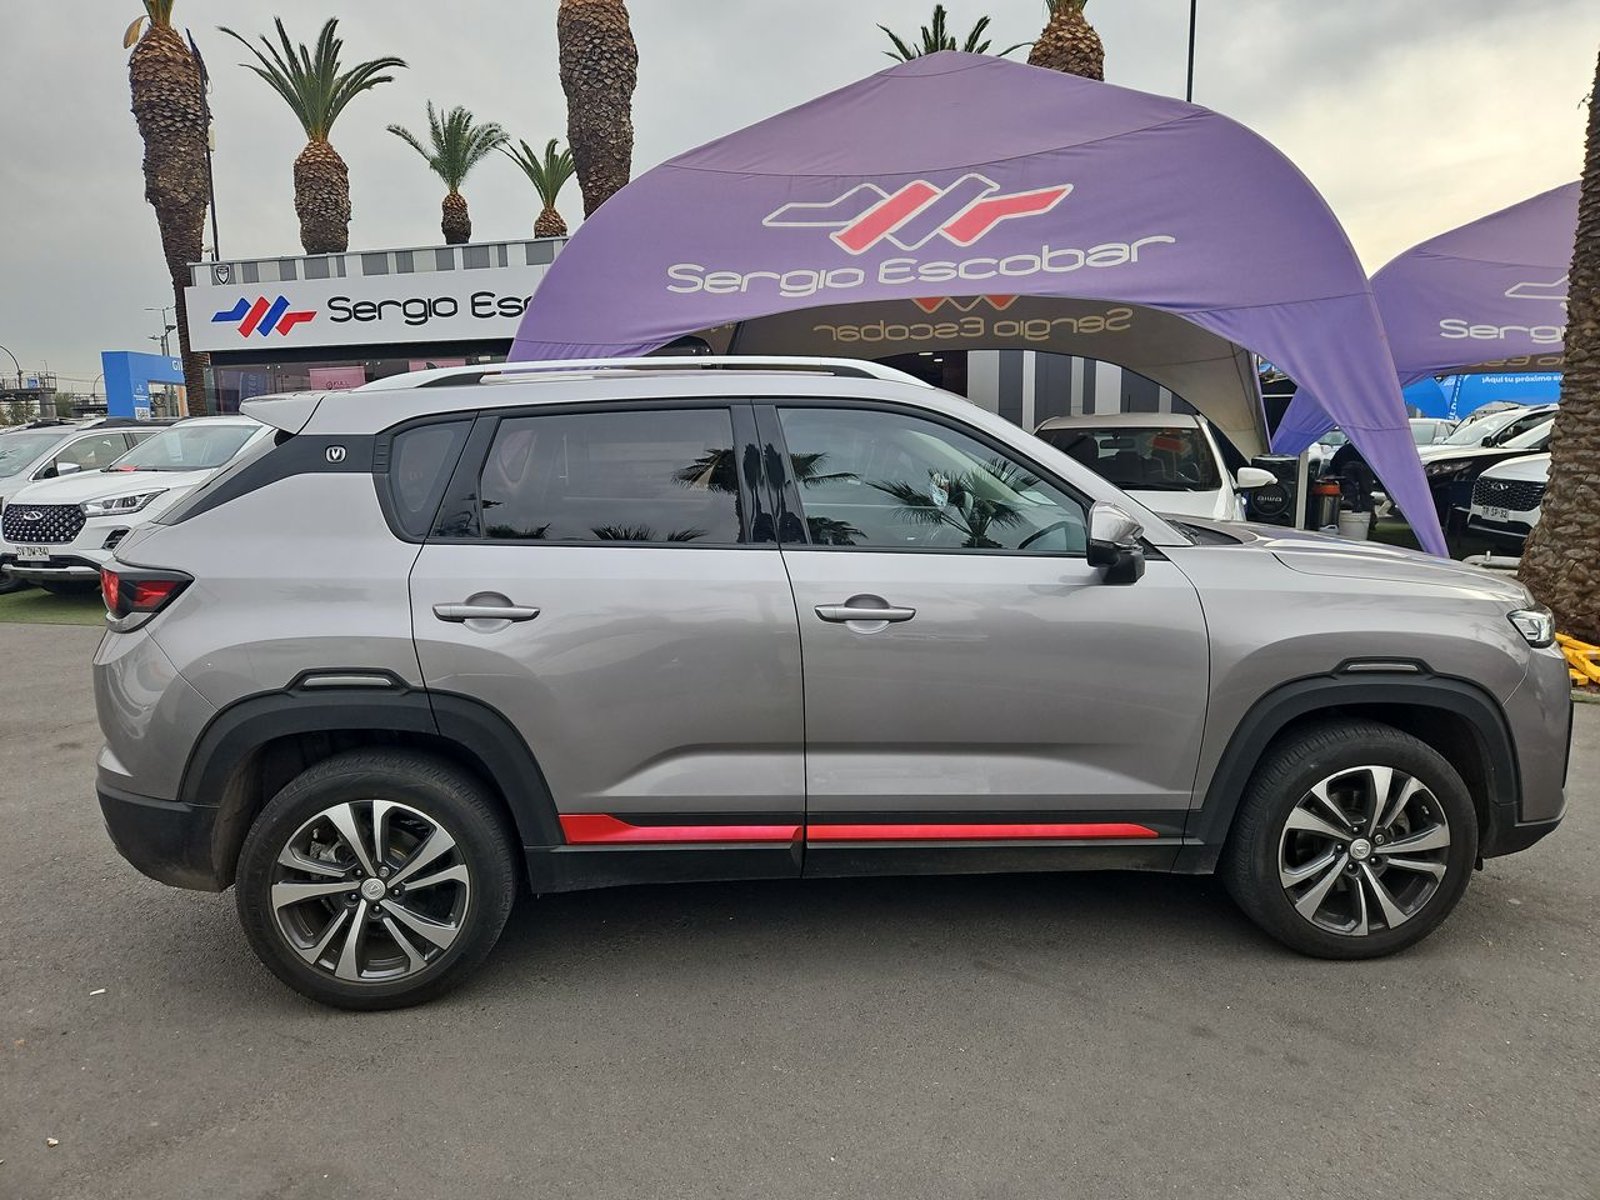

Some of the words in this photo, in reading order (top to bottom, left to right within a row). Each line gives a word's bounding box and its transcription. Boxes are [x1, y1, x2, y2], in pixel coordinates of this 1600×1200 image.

[666, 263, 865, 297] Sergio
[878, 235, 1176, 285] Escobar
[326, 295, 459, 326] Sergio
